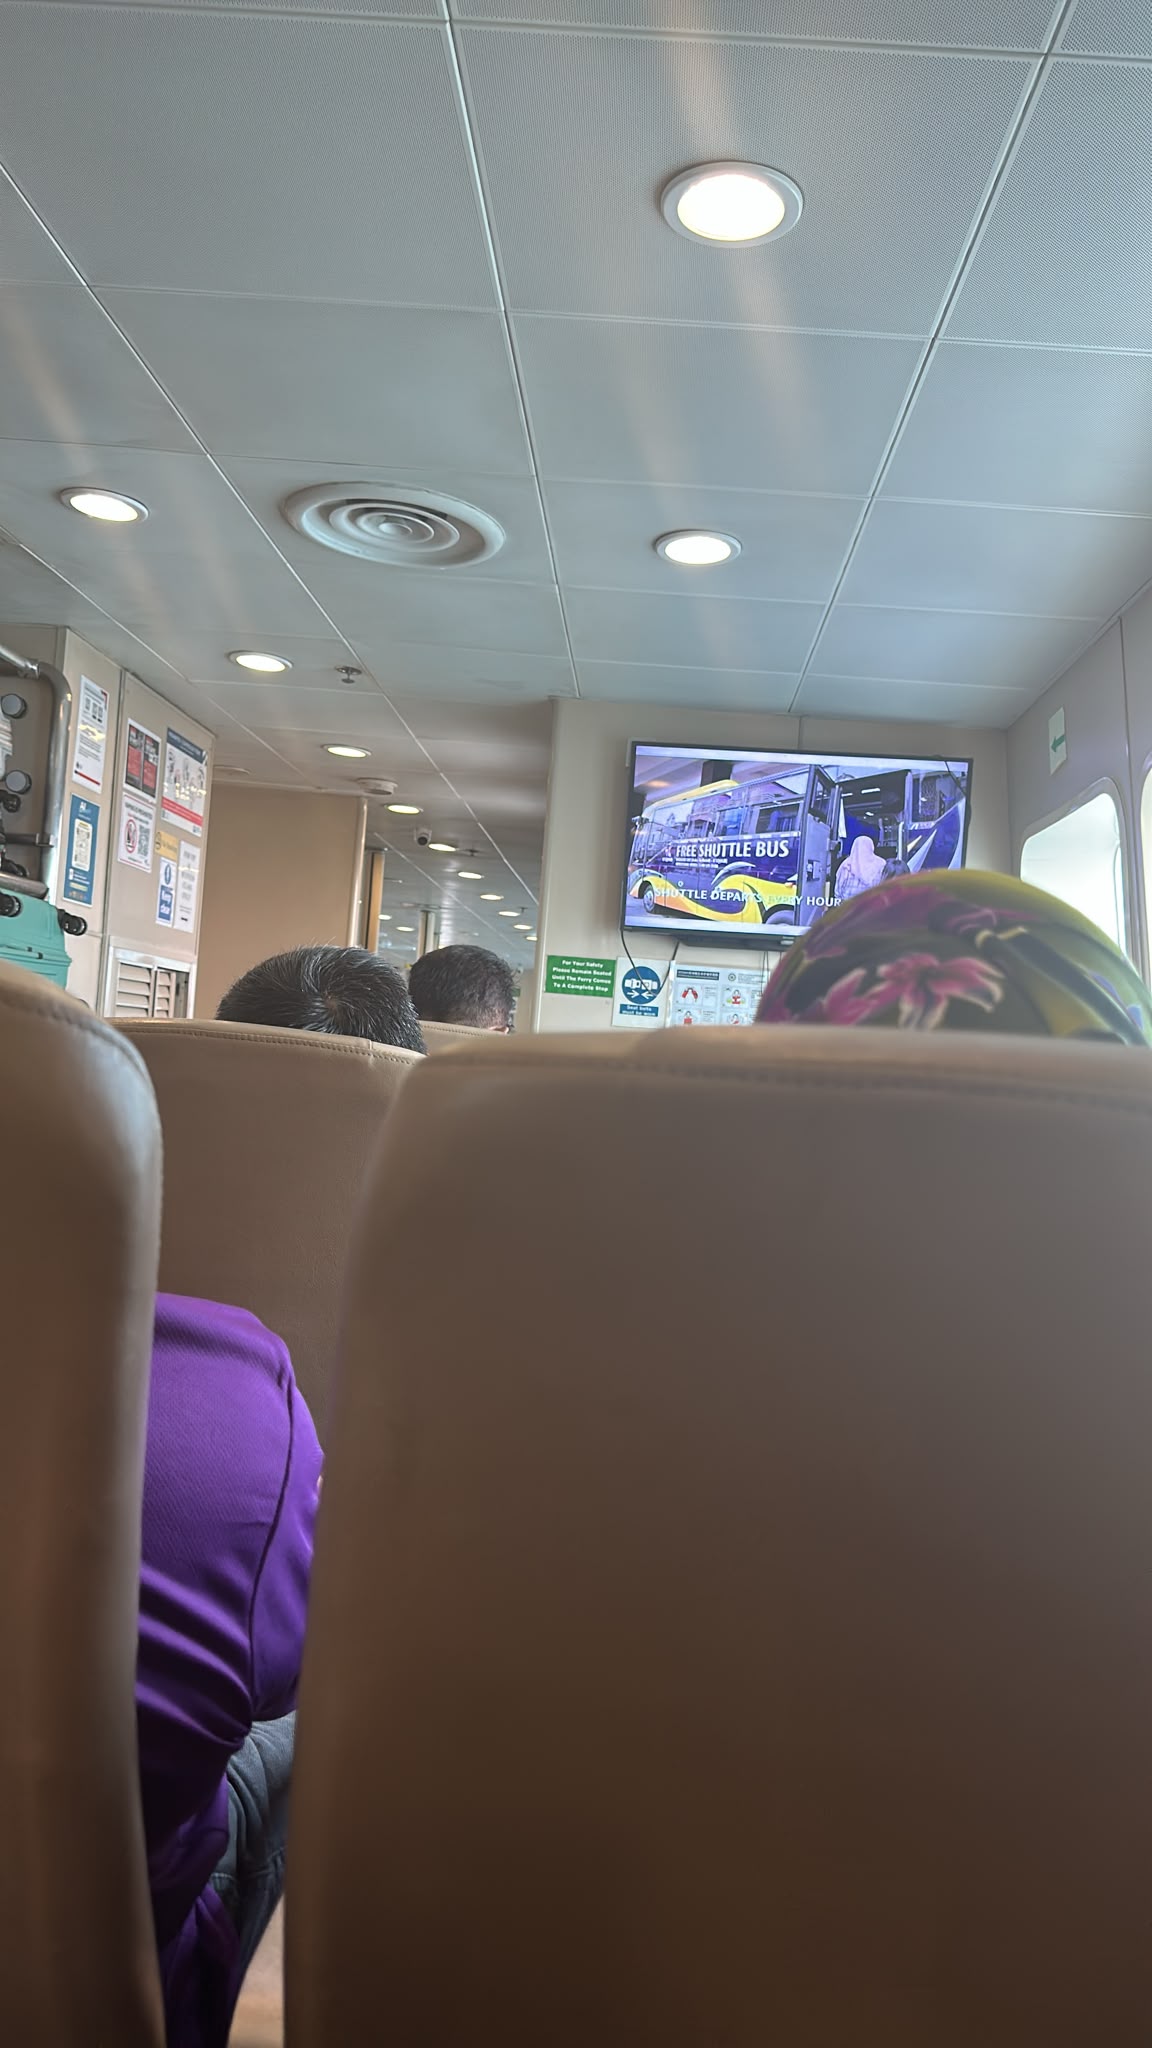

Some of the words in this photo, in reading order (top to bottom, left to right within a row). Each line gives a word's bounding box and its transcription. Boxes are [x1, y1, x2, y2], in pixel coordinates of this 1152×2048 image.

[676, 843, 697, 857] FREE
[699, 842, 751, 858] SHUTTLE
[755, 840, 790, 858] BUS
[654, 888, 707, 900] SHUTTLE
[710, 890, 762, 903] DEPARTS
[767, 894, 803, 905] EVERY
[806, 896, 842, 907] HOUR
[577, 976, 592, 984] Ferry
[567, 983, 594, 991] Complete
